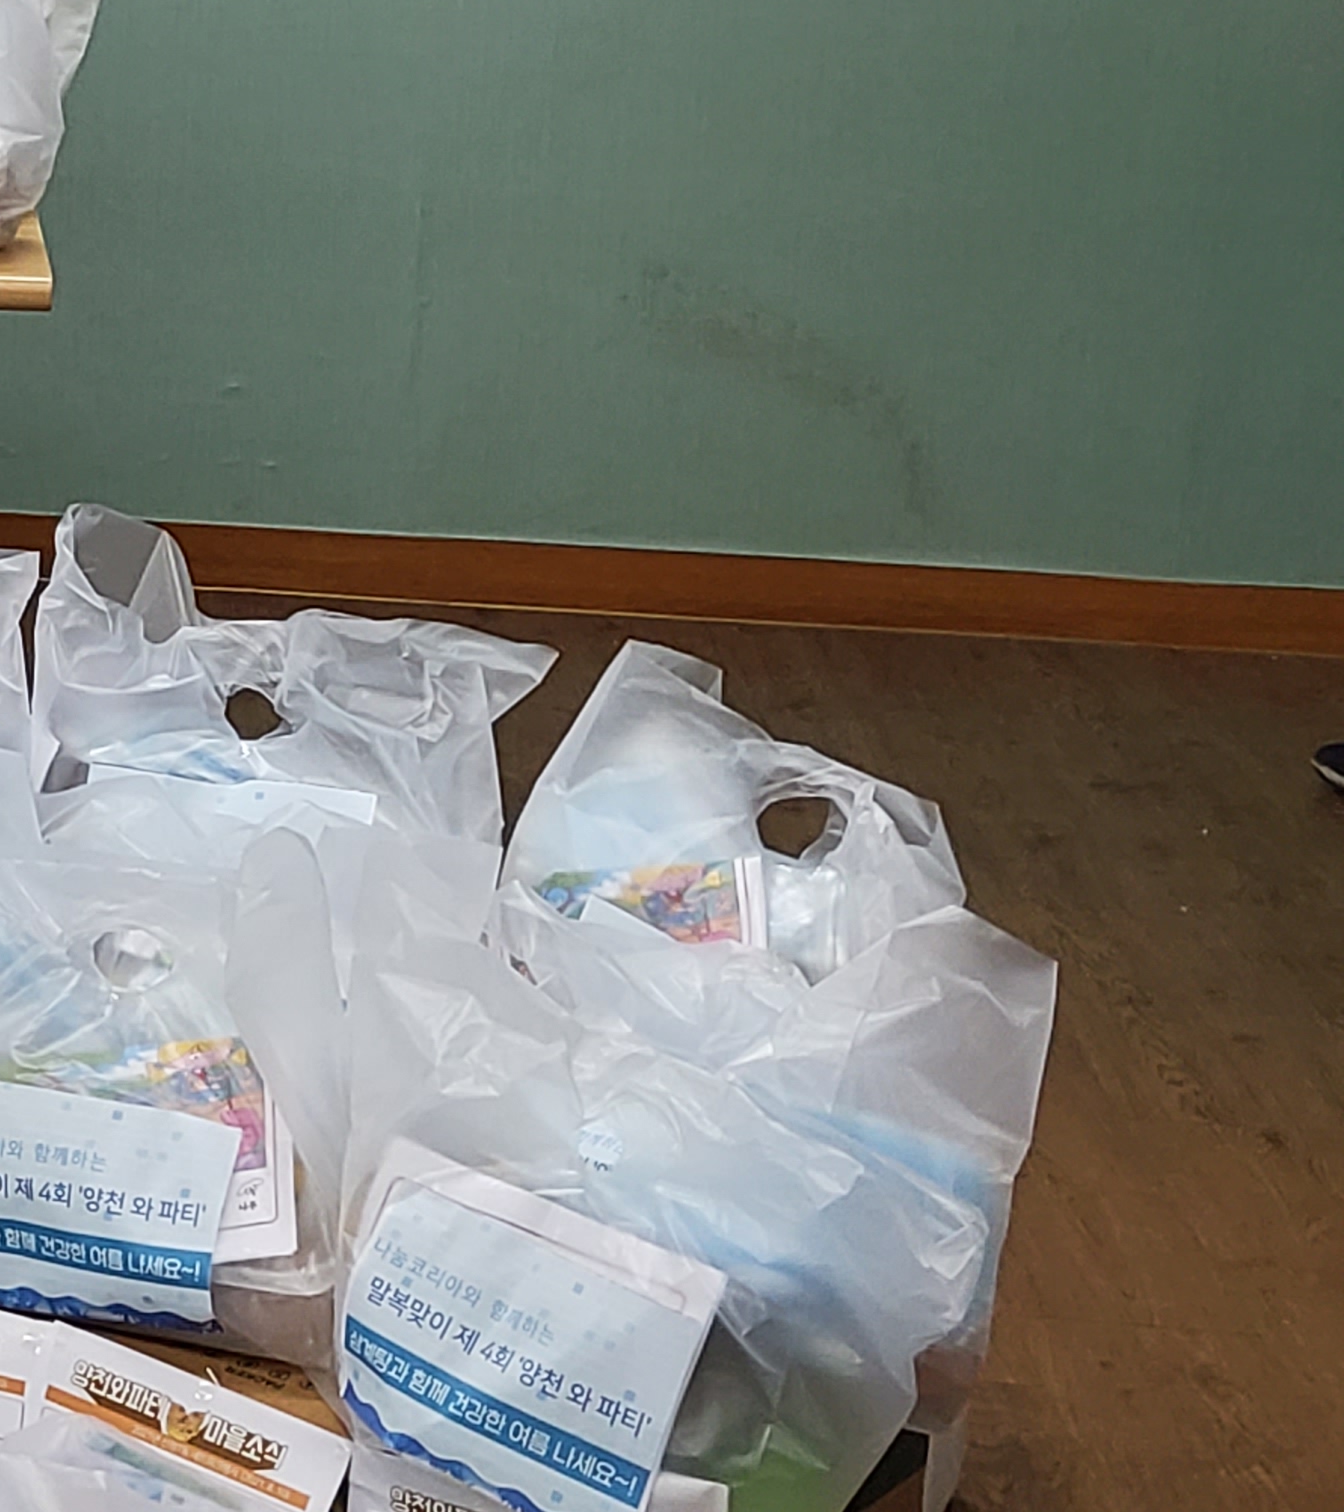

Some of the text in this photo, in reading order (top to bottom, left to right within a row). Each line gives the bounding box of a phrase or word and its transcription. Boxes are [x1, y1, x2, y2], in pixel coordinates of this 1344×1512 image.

[34, 1143, 108, 1173] 함께하는
[14, 1177, 35, 1202] 제
[38, 1181, 73, 1208] 4회
[78, 1187, 125, 1216] '양천
[130, 1196, 155, 1220] 와
[159, 1201, 206, 1227] 파티'
[4, 1229, 36, 1252] 함께
[38, 1237, 86, 1264] 건강한
[89, 1246, 123, 1269] 여름
[372, 1236, 555, 1347] 나눔코리아와 함께하는
[348, 1328, 412, 1384] 삼계탕과
[407, 1366, 449, 1405] 함께
[448, 1390, 509, 1436] 건강한
[509, 1420, 552, 1454] 여름
[367, 1274, 653, 1438] 말복맞이 제 4회 '양천 와 파티'
